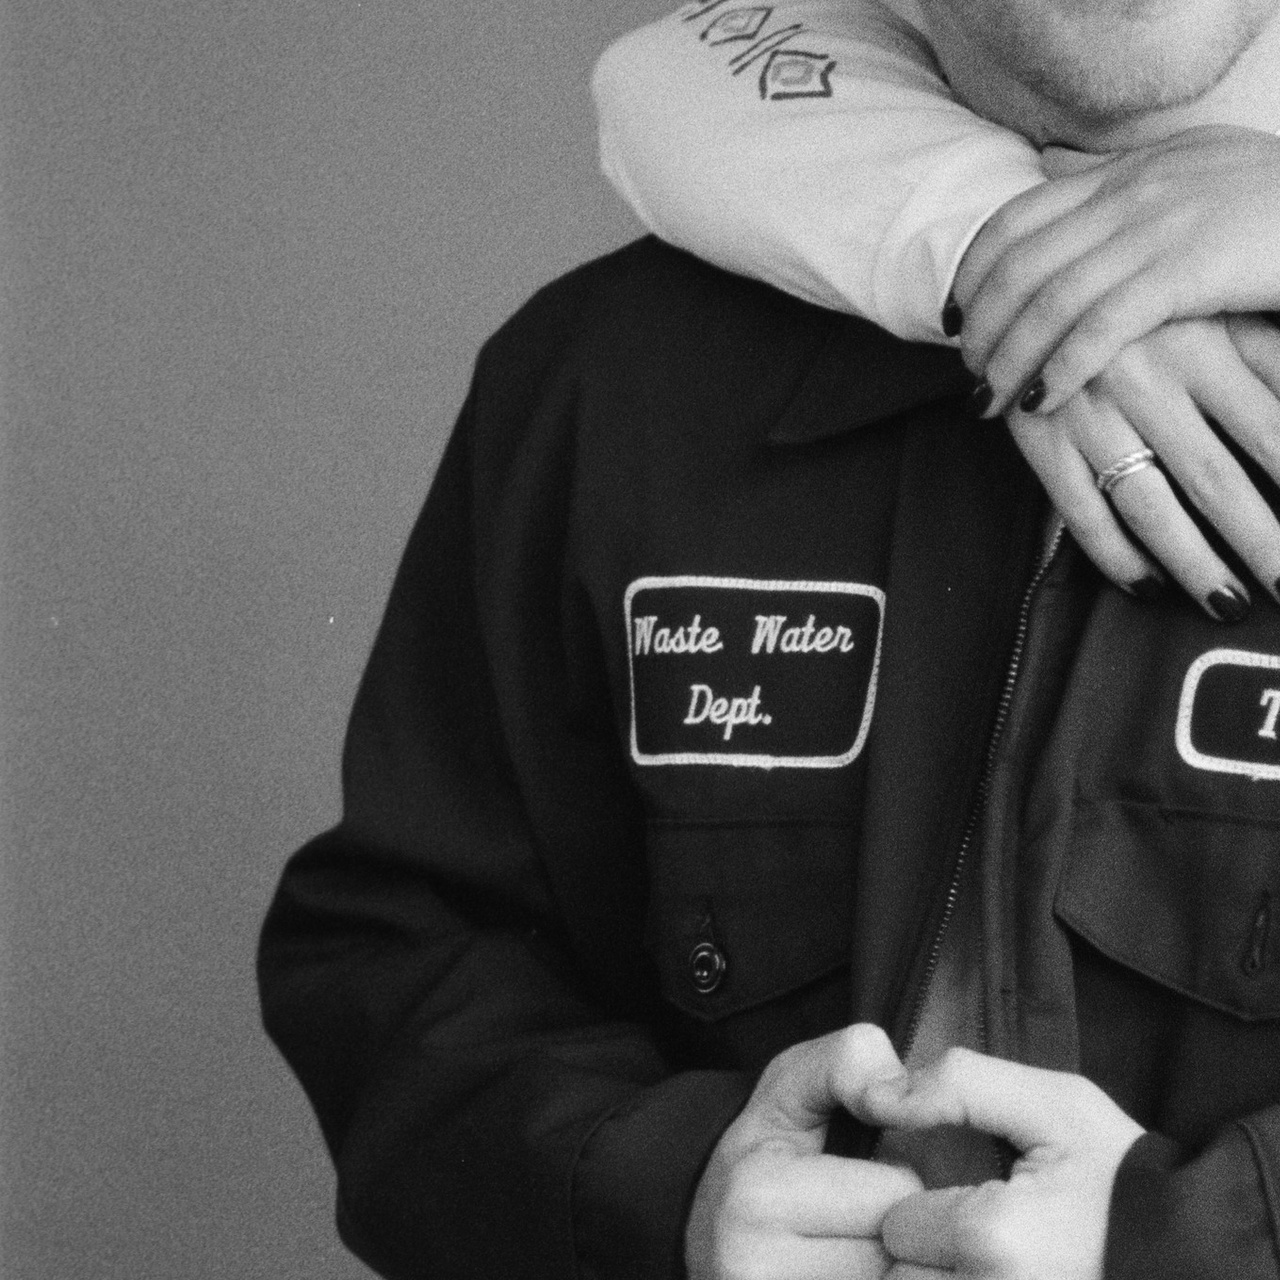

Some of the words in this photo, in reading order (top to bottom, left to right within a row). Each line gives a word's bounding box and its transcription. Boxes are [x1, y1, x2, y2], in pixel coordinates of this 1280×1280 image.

[635, 615, 723, 655] Waste
[751, 615, 854, 654] Water
[684, 684, 772, 740] Dept.
